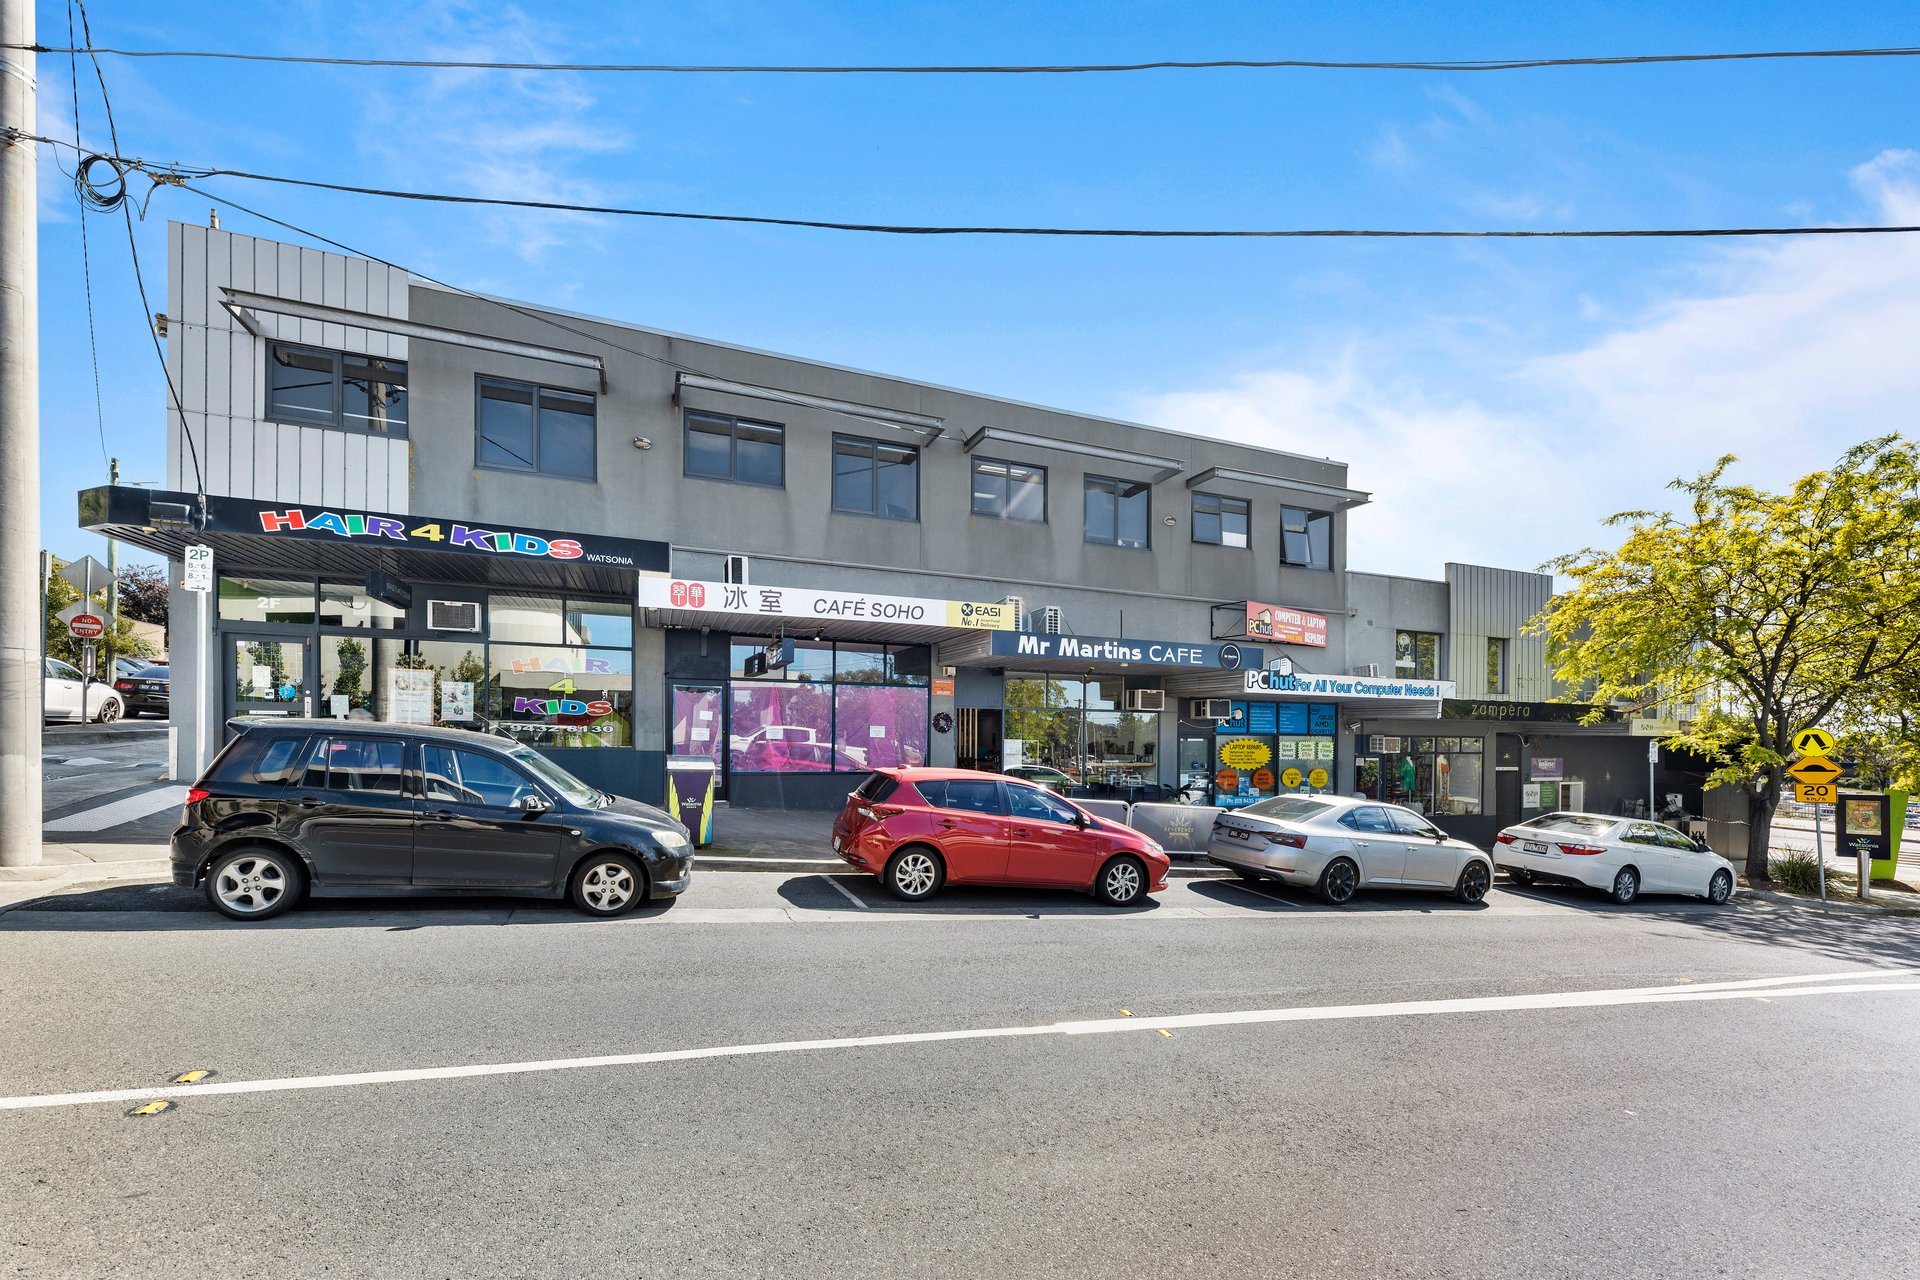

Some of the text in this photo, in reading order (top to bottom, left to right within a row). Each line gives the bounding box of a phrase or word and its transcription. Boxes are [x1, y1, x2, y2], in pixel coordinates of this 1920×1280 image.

[258, 509, 633, 566] HAIR 4 KIDS WATSONIA
[189, 549, 210, 560] 2P
[257, 597, 281, 608] 2F
[813, 598, 924, 620] CAFÉ SOHO
[975, 606, 1001, 617] EASI
[1274, 609, 1301, 625] COMPUTER
[1307, 615, 1326, 630] LAPTOP
[74, 627, 98, 635] ENTRY
[1017, 635, 1203, 664] Mr Martins CAFE
[511, 657, 613, 674] HAIR
[548, 678, 577, 694] 4
[1295, 678, 1312, 692] For
[1313, 679, 1328, 693] All
[1329, 679, 1354, 694] Your
[1354, 681, 1403, 698] Computer
[1404, 683, 1435, 697] Needs
[514, 696, 613, 716] KIDS
[509, 724, 560, 733] 9432
[1314, 721, 1329, 729] AMD
[1803, 785, 1829, 796] 20
[1848, 841, 1880, 849] Watsonia
